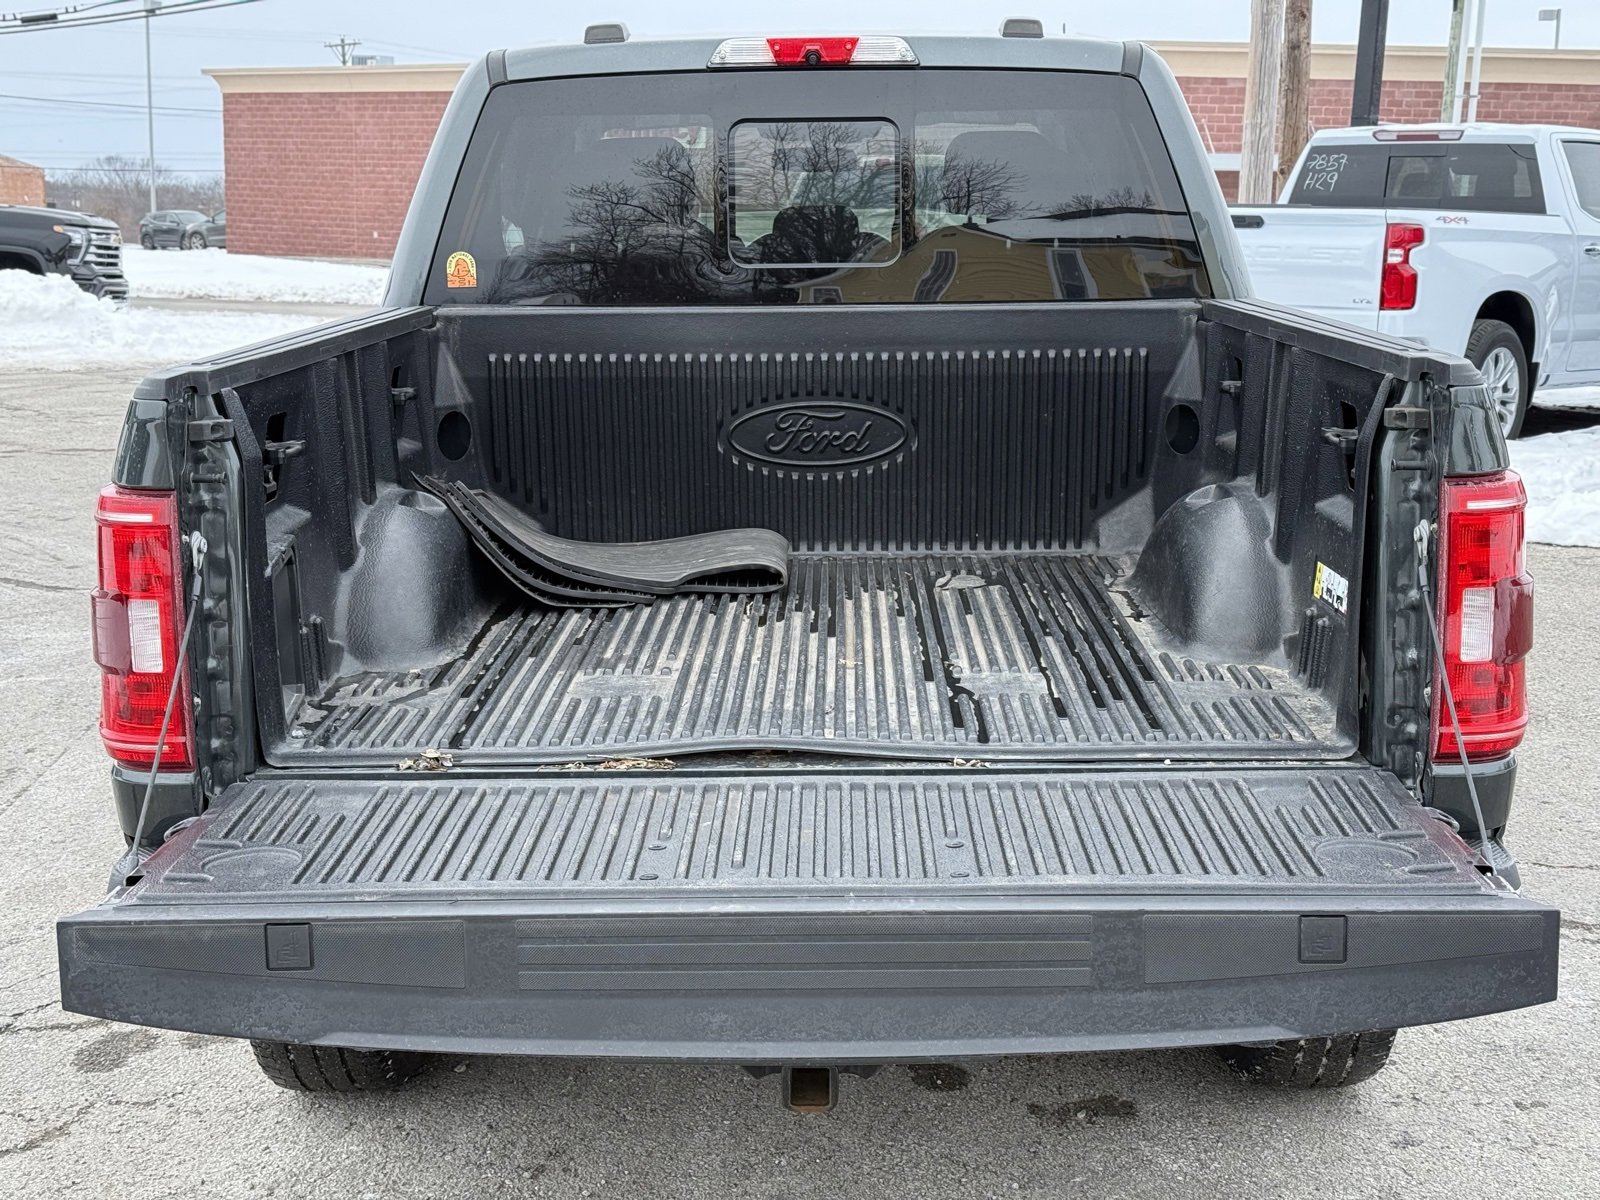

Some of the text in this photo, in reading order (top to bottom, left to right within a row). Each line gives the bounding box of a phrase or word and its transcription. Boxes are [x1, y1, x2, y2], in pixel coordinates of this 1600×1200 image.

[1306, 153, 1349, 171] 7857
[1303, 171, 1338, 192] H29
[766, 409, 872, 453] Ford
